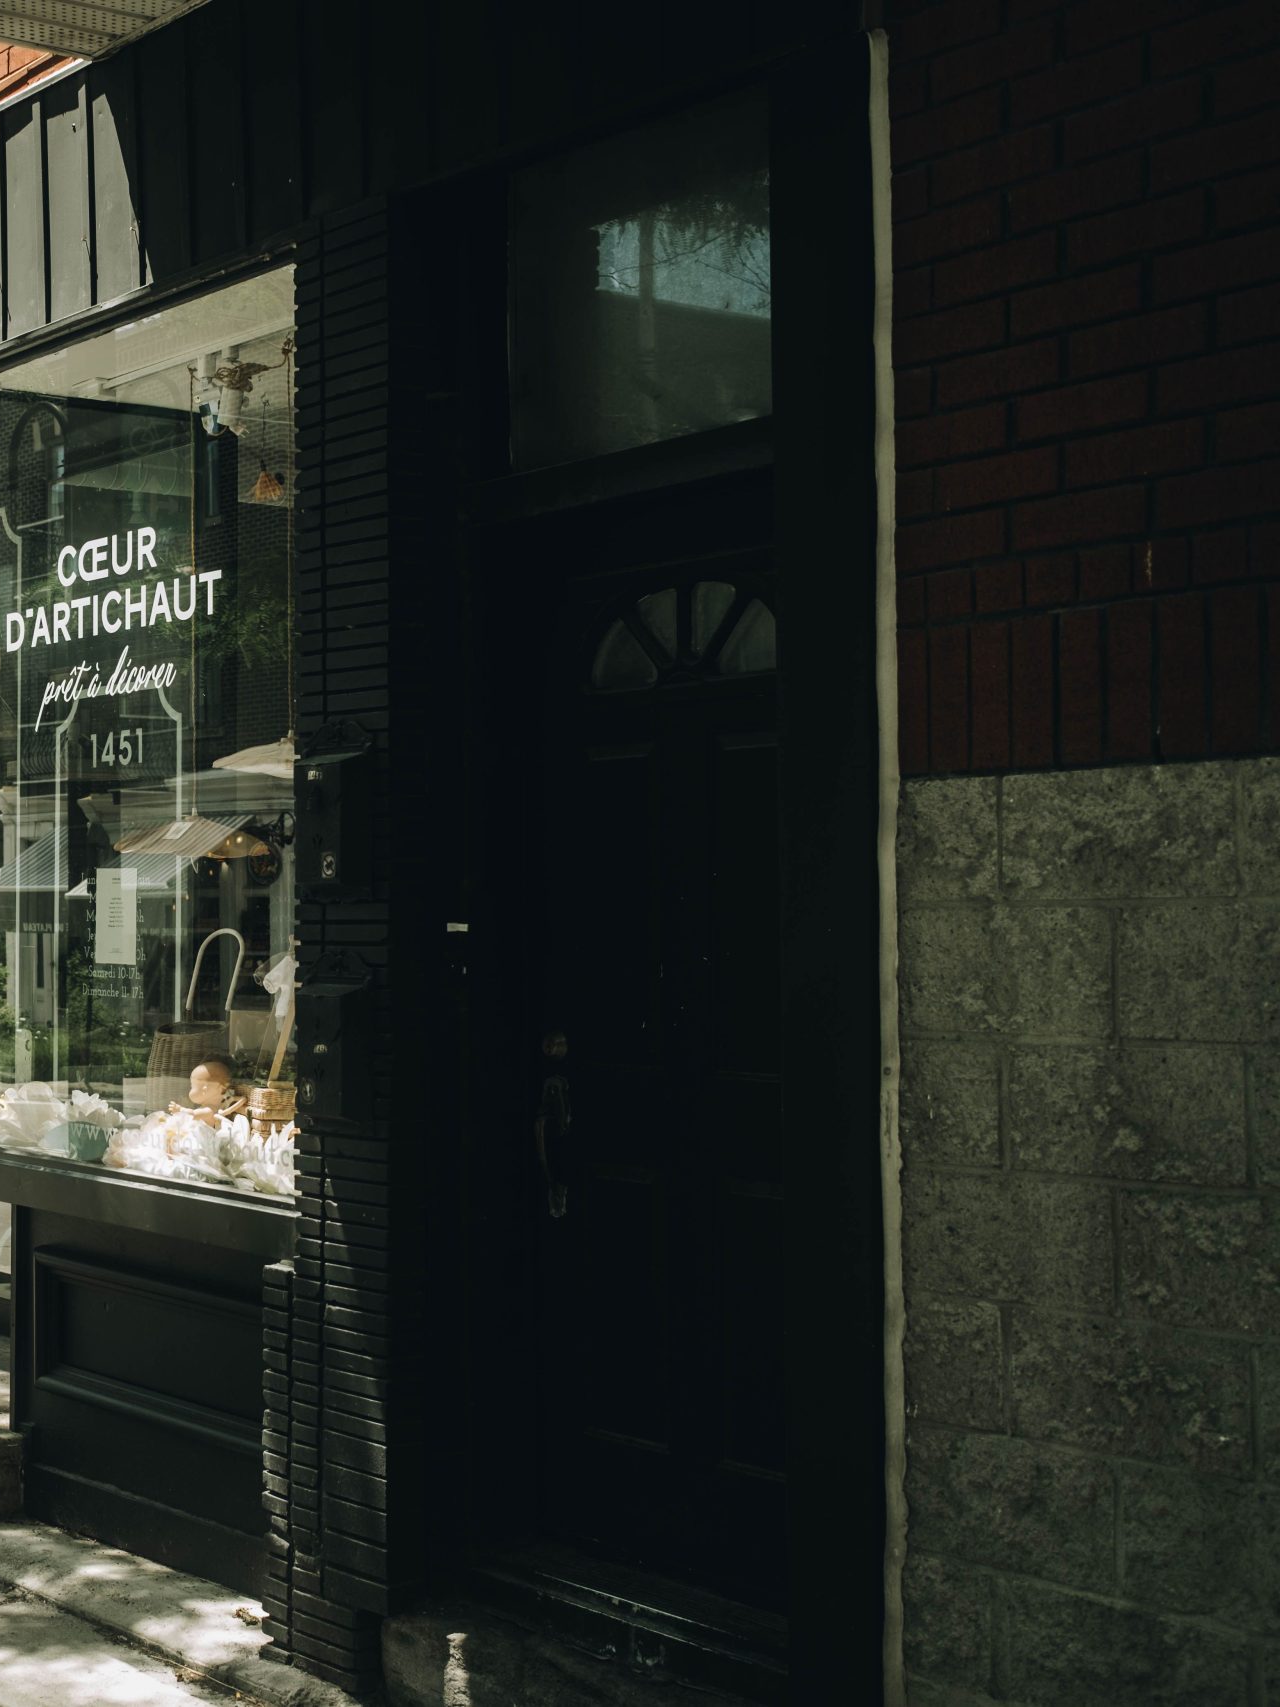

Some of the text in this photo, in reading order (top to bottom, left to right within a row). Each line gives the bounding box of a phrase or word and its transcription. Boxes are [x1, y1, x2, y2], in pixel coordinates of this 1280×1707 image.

[57, 526, 157, 587] CŒUR
[6, 569, 222, 652] D'ARTICHAUT
[35, 645, 177, 732] prêt à décorer
[90, 727, 143, 768] 1451
[82, 982, 120, 998] Dimanche
[88, 964, 116, 979] Samedi
